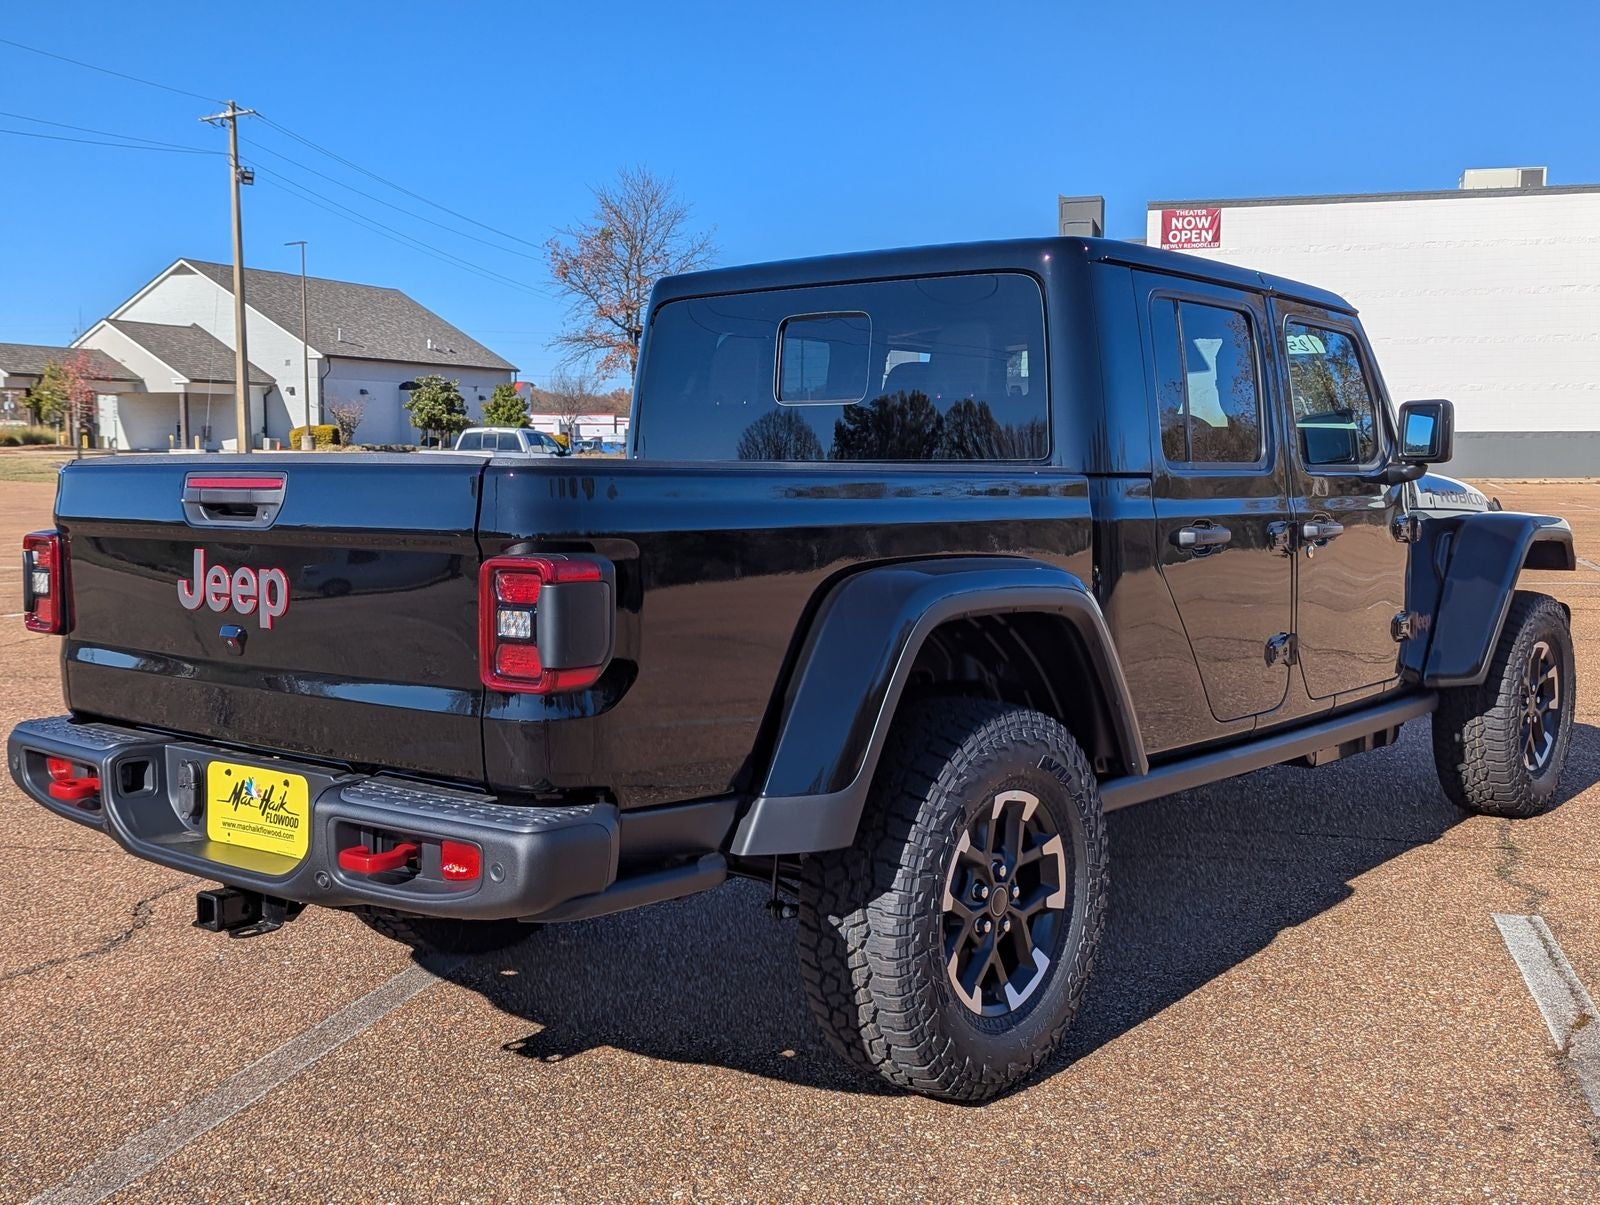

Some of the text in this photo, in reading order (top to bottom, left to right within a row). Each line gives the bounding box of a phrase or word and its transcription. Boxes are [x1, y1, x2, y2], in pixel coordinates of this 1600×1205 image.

[1171, 217, 1211, 229] NOW
[1168, 230, 1213, 243] OPEN
[176, 547, 290, 630] Jeep
[216, 779, 300, 816] Mac Haik
[265, 811, 300, 829] FLOWOOD
[221, 820, 295, 841] www.machaikflowood.com
